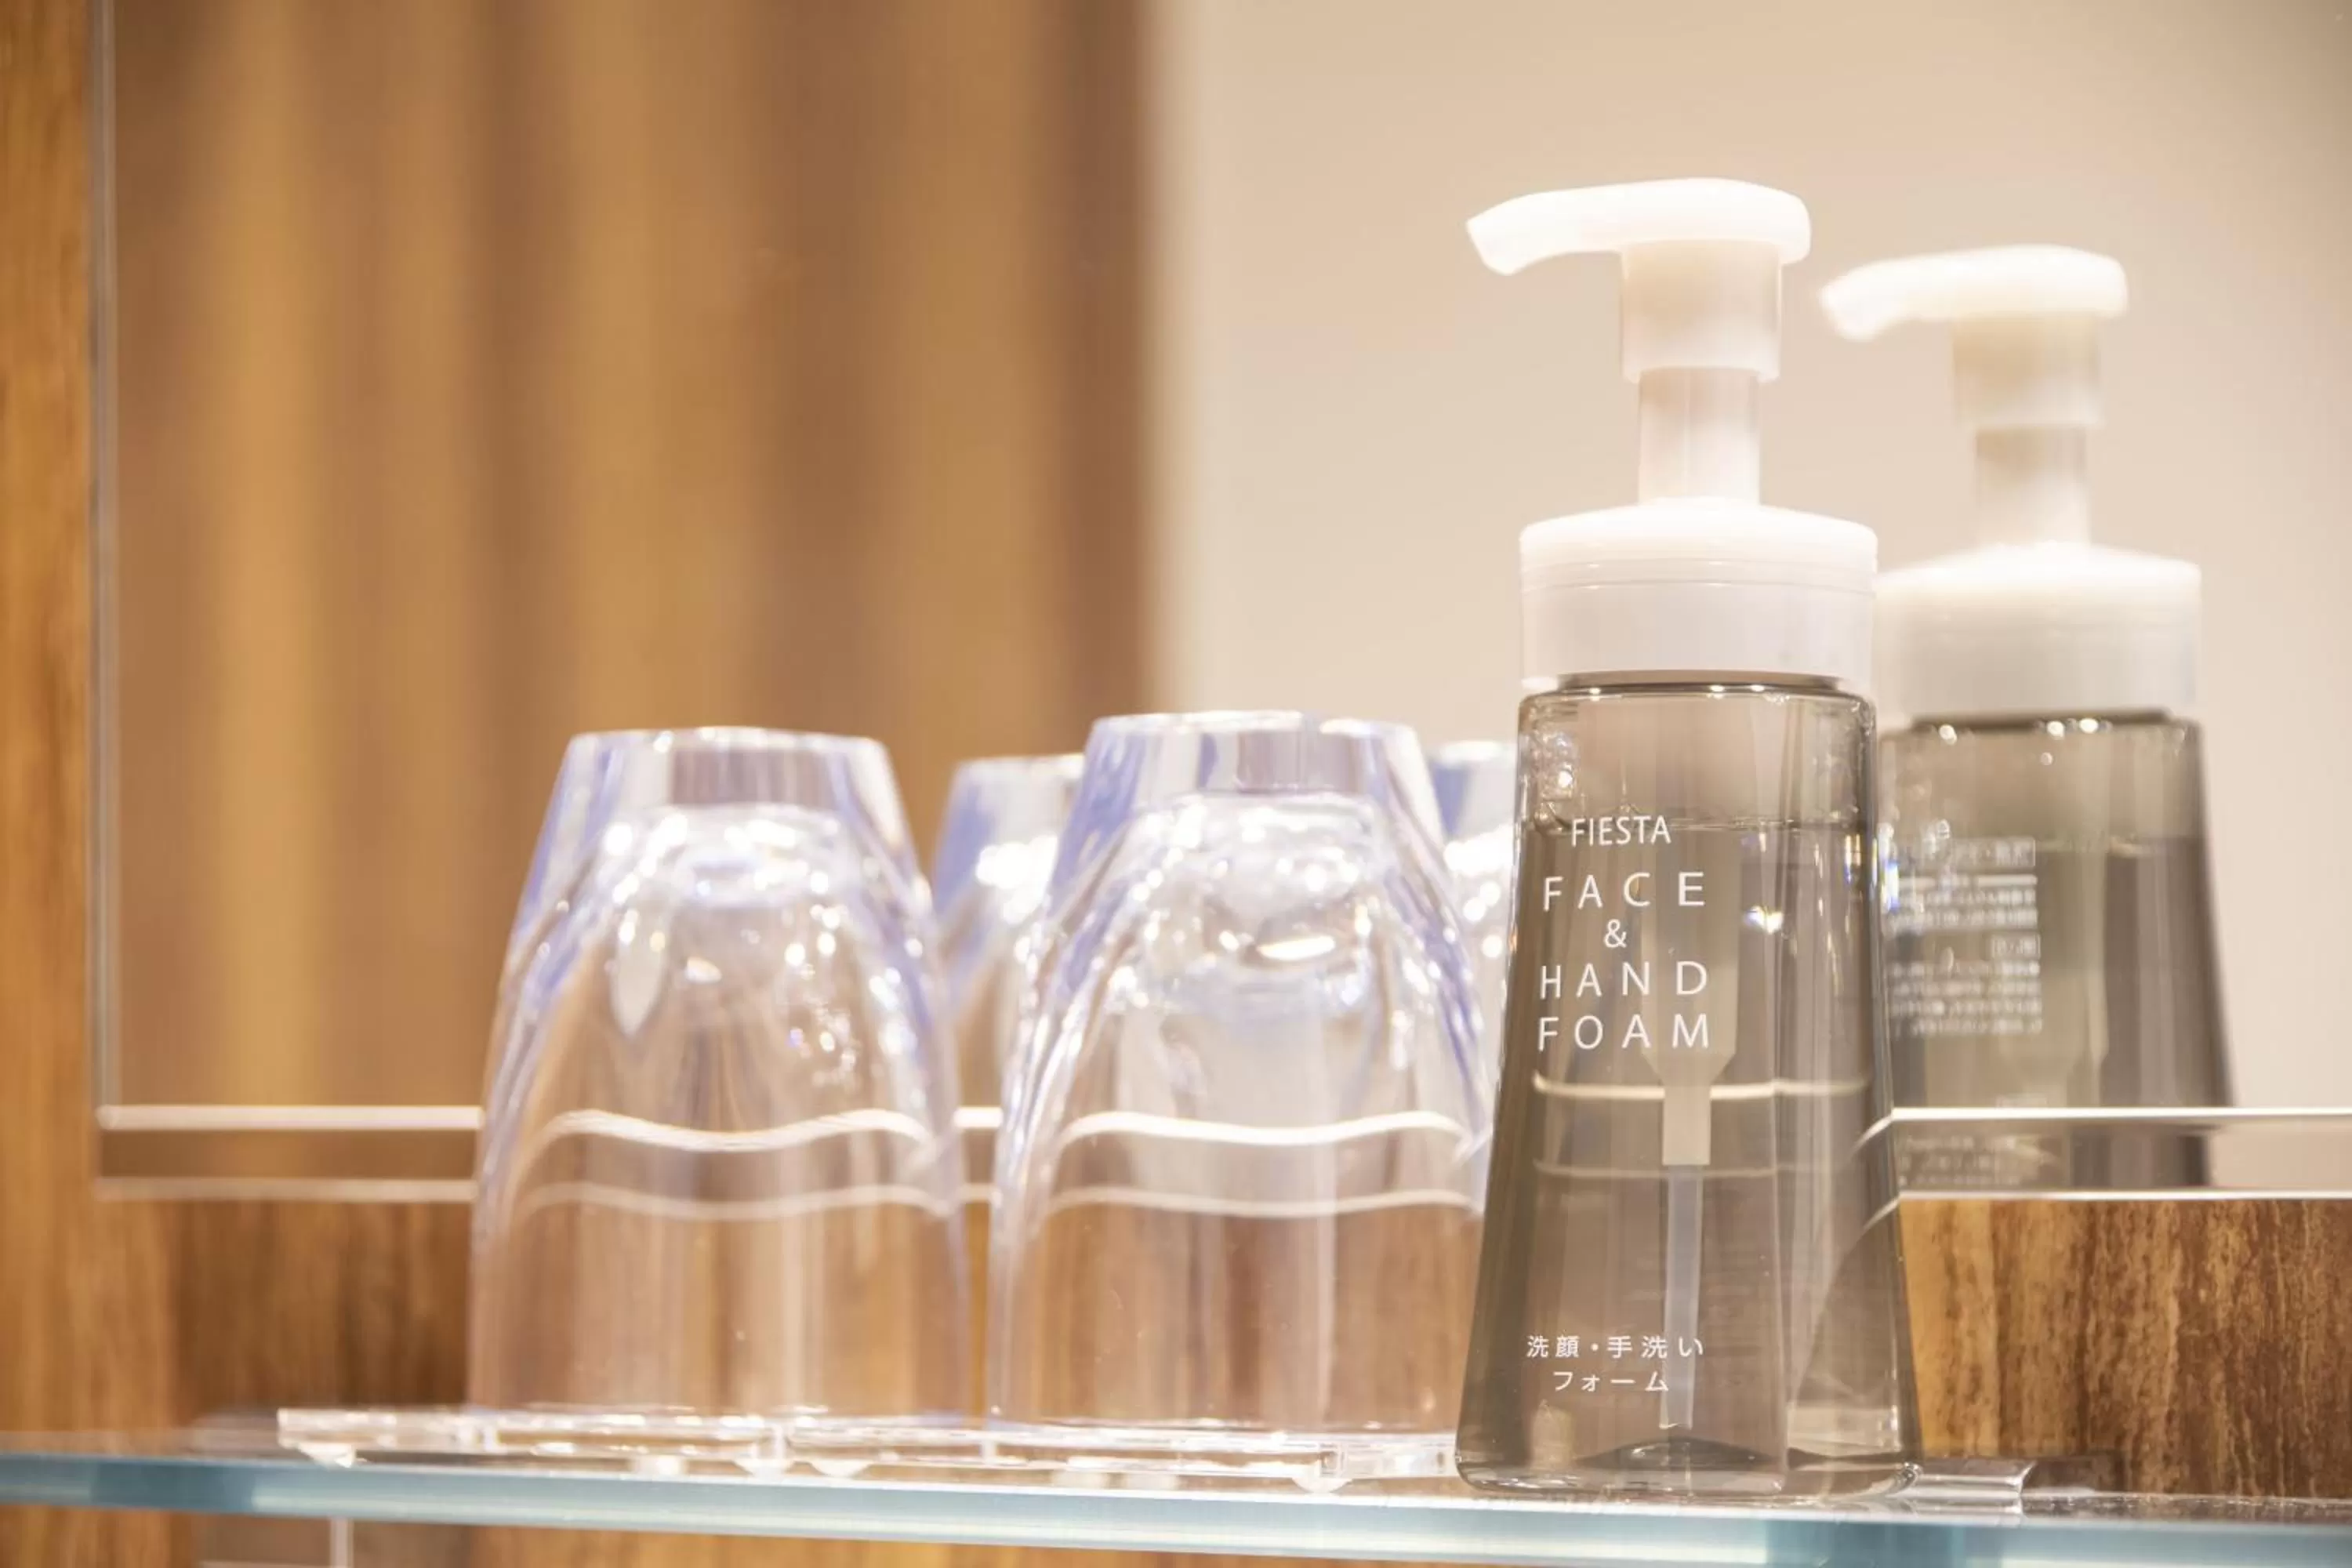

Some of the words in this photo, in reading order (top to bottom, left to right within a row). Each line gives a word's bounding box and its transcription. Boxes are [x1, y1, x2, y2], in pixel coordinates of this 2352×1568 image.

[1571, 815, 1671, 847] FIESTA
[1543, 871, 1705, 912] FACE
[1603, 919, 1628, 948] &
[1540, 960, 1708, 999] HAND
[1538, 1014, 1709, 1051] FOAM
[1526, 1335, 1704, 1359] 洗顔・手洗い
[1553, 1371, 1669, 1392] フォーム
